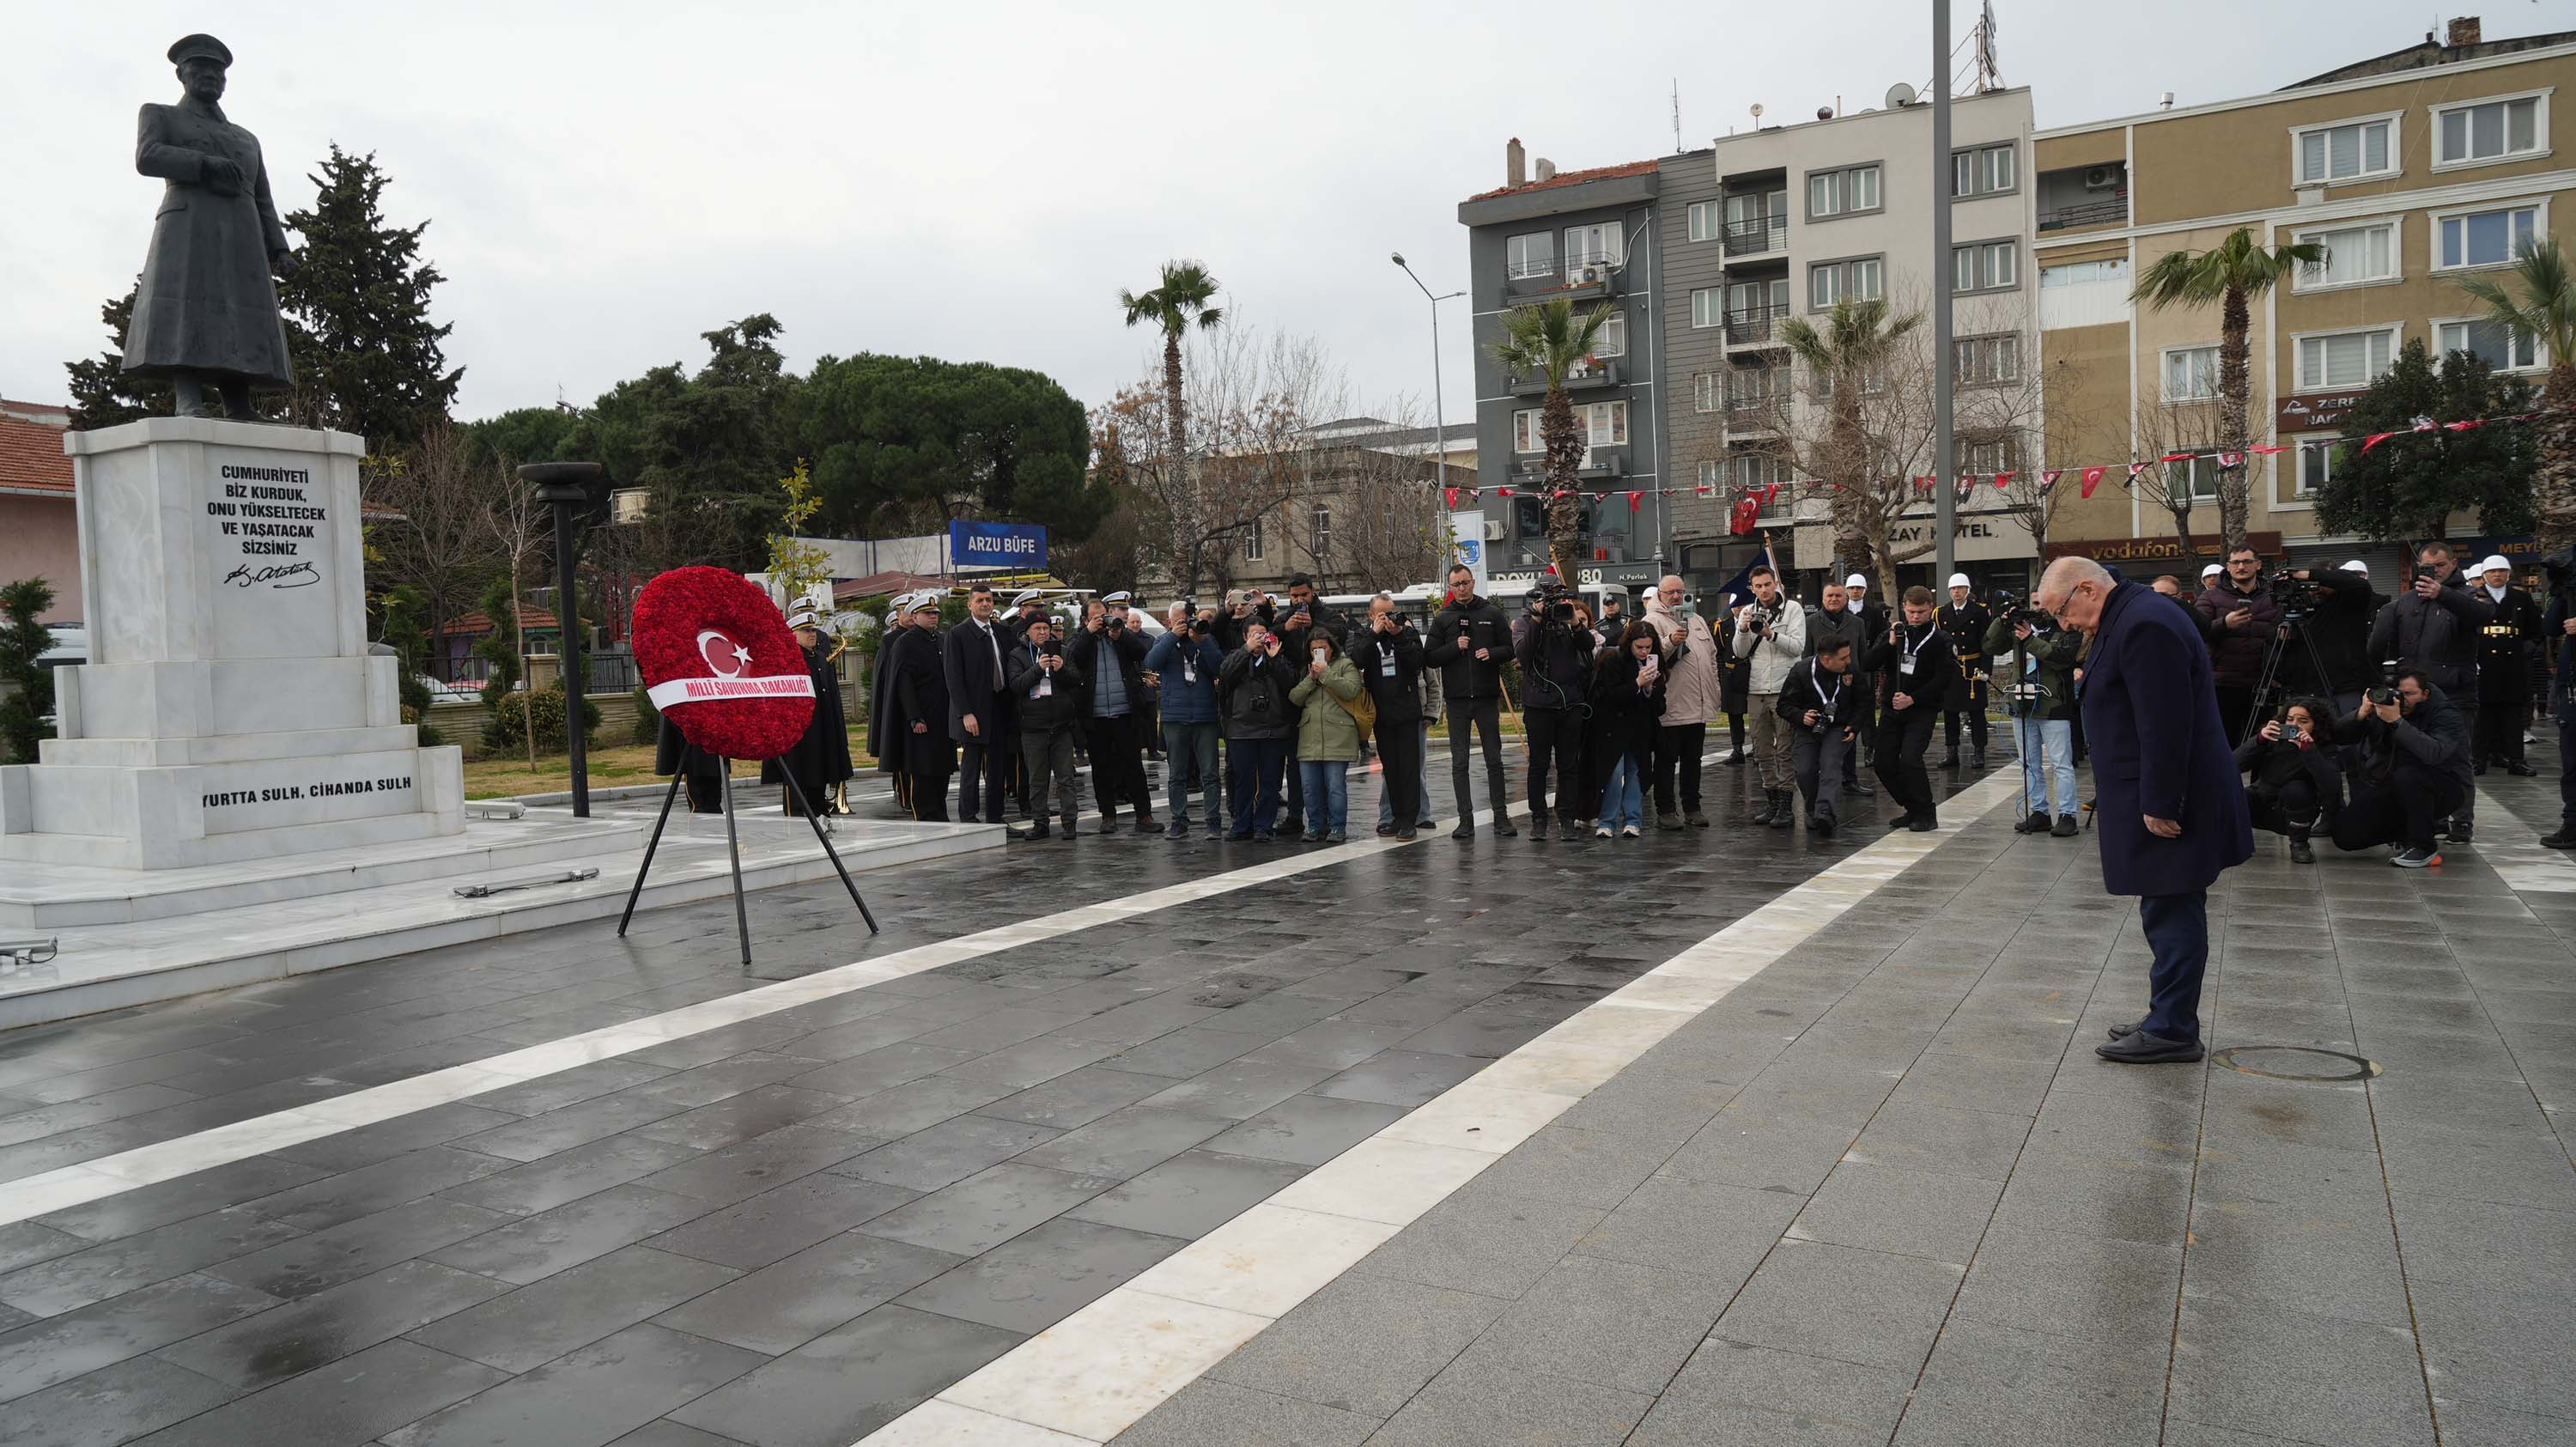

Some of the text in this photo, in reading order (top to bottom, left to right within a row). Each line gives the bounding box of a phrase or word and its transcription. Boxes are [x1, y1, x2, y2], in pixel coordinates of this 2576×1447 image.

[222, 465, 309, 483] CUMHURİYETİ
[226, 482, 307, 503] BİZ KURDUK,
[207, 502, 326, 520] ONU YÜKSELTECEK
[222, 521, 314, 538] VE YAŞATACAK
[241, 538, 298, 556] SİZSİNİZ
[968, 535, 1036, 554] ARZU BÜFE
[2090, 541, 2186, 560] vodafon
[714, 681, 763, 696] SAVUNMA
[761, 677, 809, 694] BAKANLIĞI
[261, 786, 305, 802] SULH,
[309, 781, 374, 797] CİHANDA
[377, 776, 411, 791] SULH
